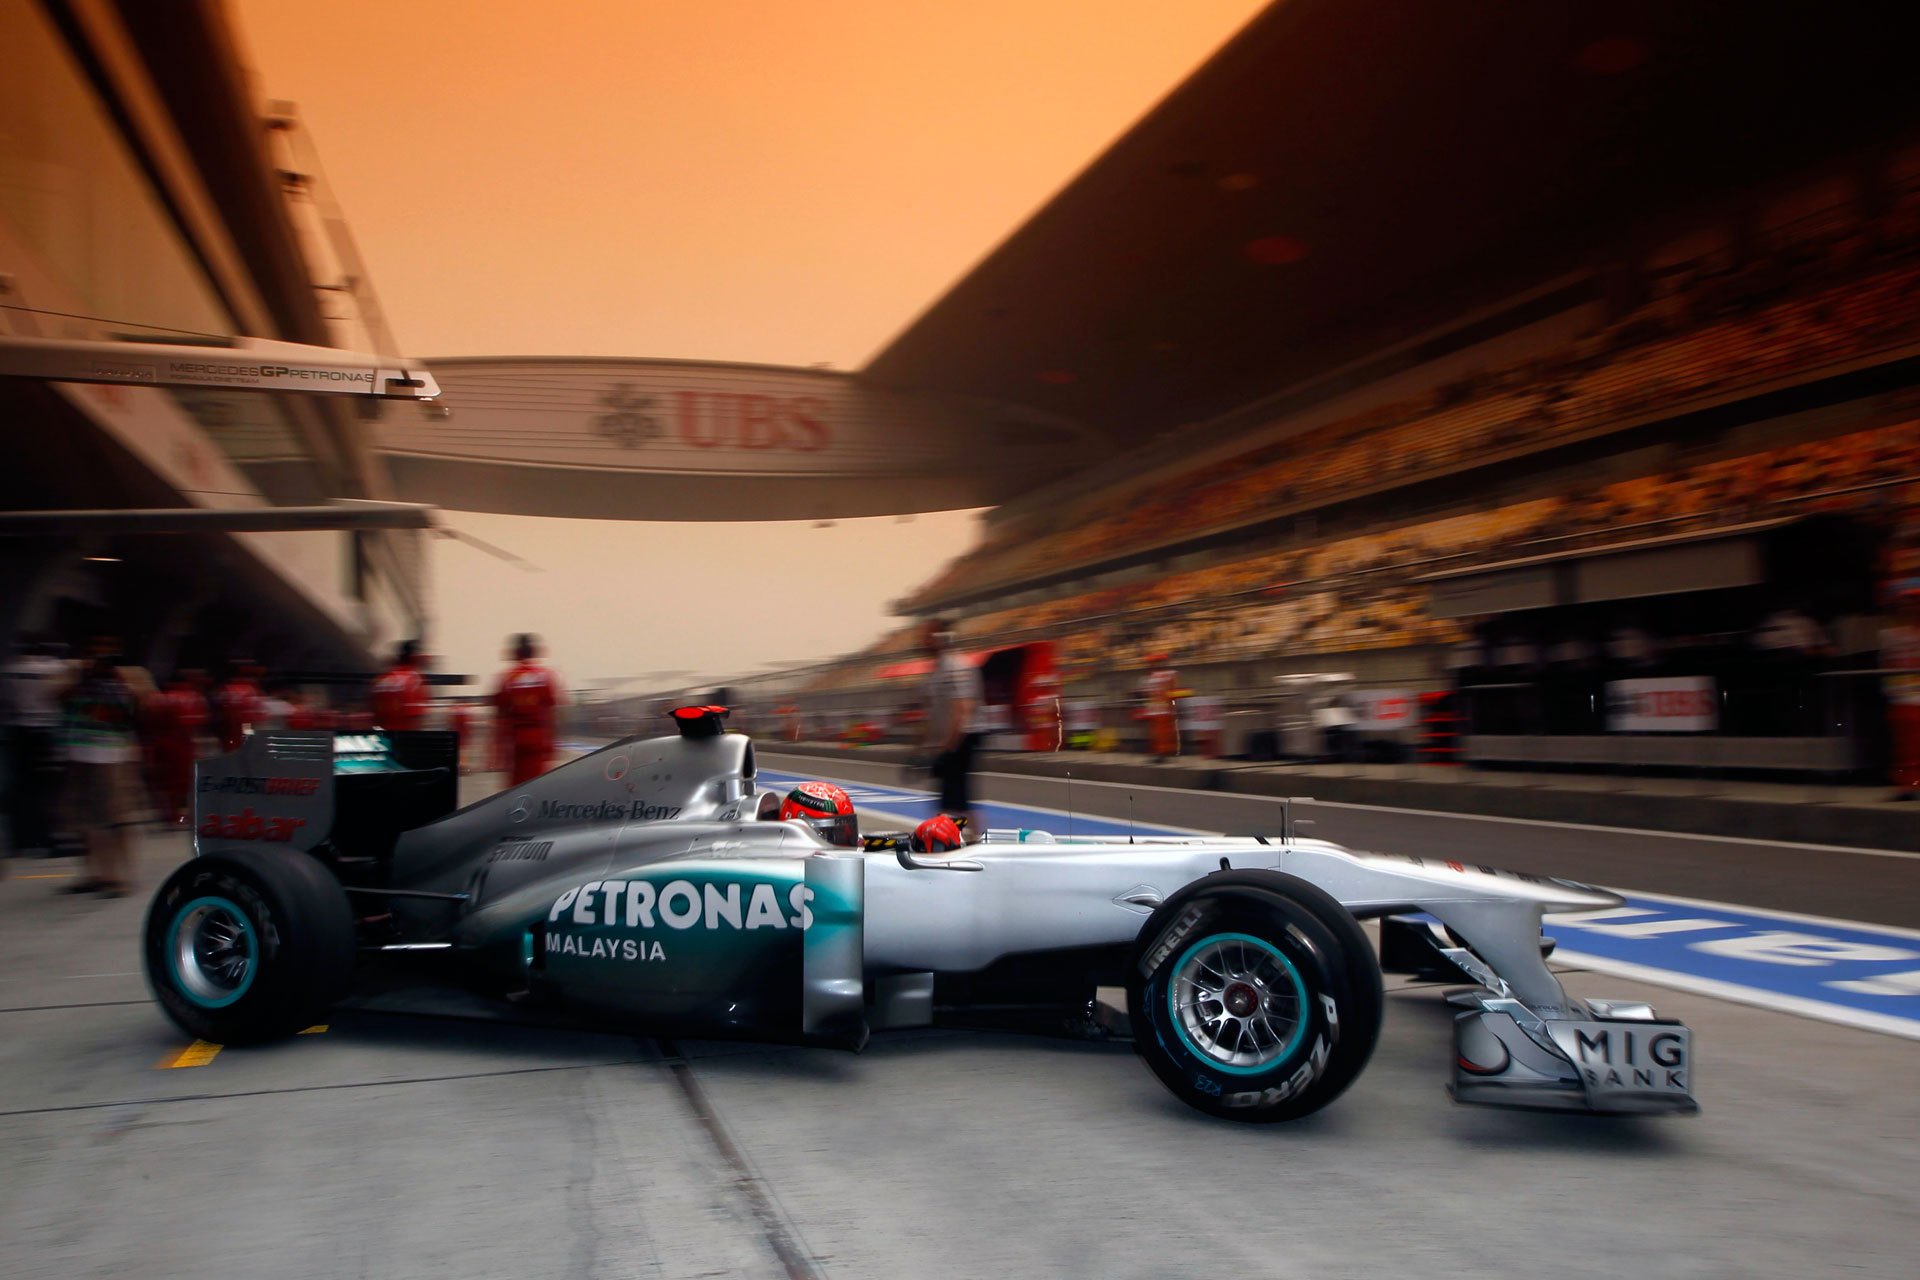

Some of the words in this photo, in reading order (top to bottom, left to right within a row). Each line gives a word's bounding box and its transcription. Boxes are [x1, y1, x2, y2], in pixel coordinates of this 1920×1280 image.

[674, 390, 833, 452] UBS
[537, 800, 682, 821] Mercedes-Benz
[549, 879, 815, 930] PETRONAS
[545, 932, 667, 962] MALAYSIA
[1573, 1028, 1682, 1067] MIG
